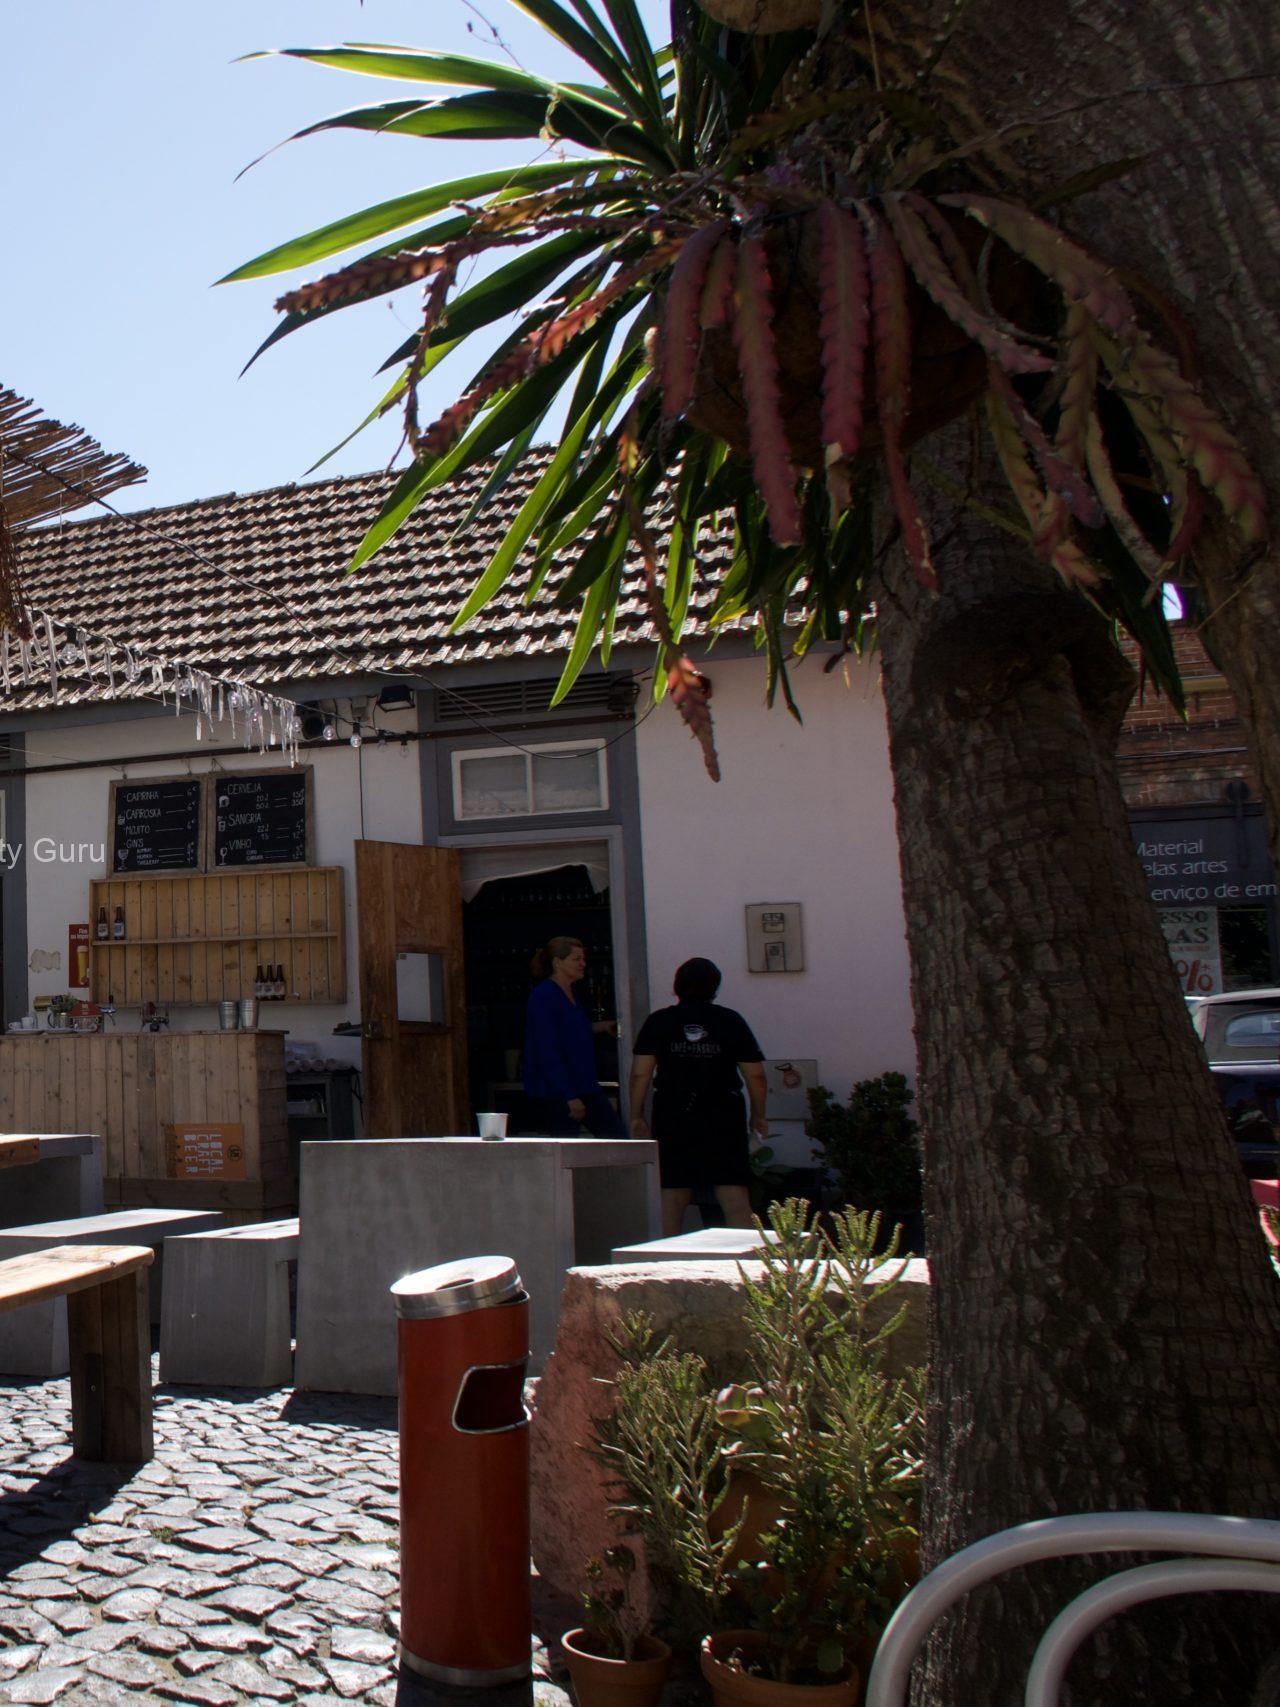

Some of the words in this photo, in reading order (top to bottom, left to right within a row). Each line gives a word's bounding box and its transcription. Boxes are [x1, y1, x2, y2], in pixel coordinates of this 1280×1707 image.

[228, 813, 261, 826] SANGRIA
[228, 838, 252, 850] VINHO
[1136, 839, 1204, 857] Material
[1142, 861, 1177, 877] elas
[1182, 860, 1228, 875] artes
[1150, 884, 1209, 902] erviço
[1213, 882, 1238, 898] de
[1244, 883, 1278, 897] em
[1160, 911, 1209, 924] ESSO
[1168, 927, 1209, 944] AS
[183, 1134, 198, 1173] BEER
[197, 1134, 211, 1172] CRAFT
[209, 1134, 224, 1174] LOCAL
